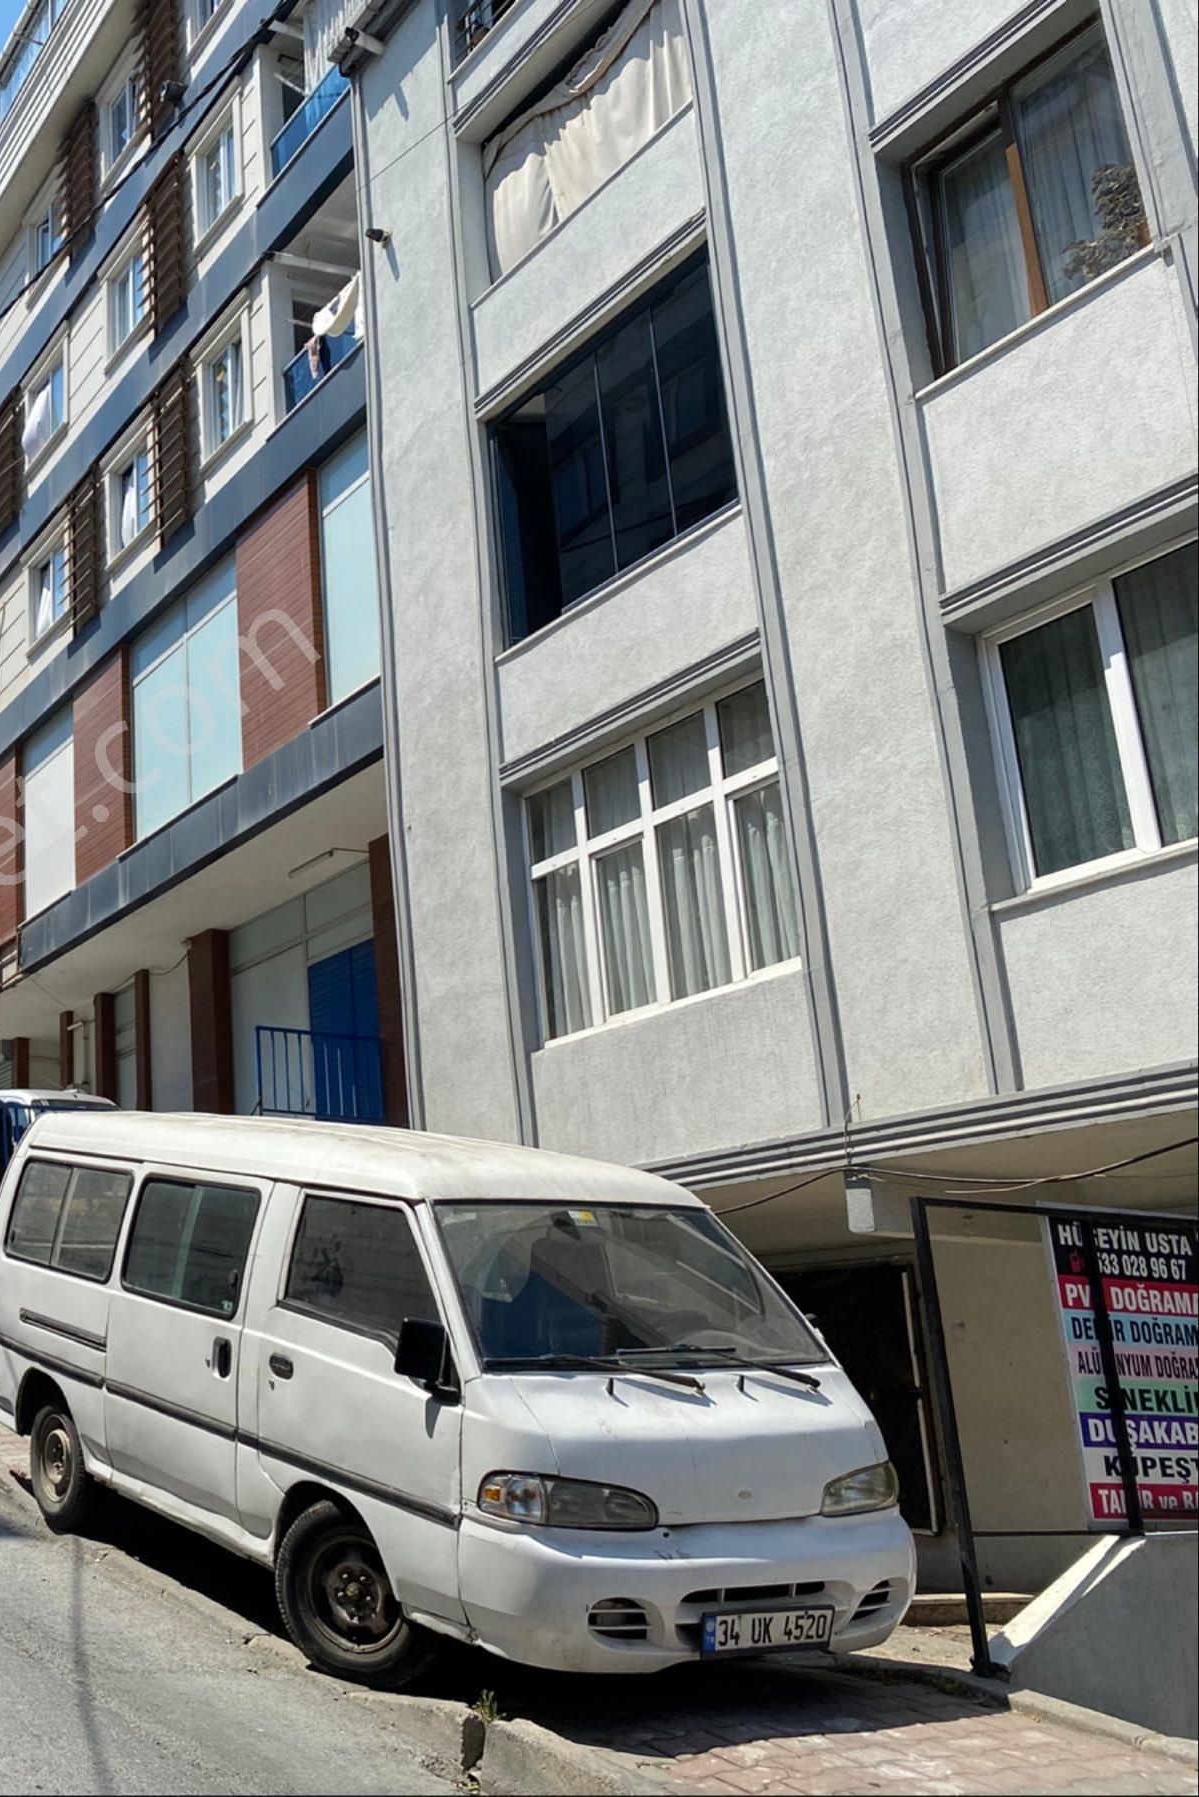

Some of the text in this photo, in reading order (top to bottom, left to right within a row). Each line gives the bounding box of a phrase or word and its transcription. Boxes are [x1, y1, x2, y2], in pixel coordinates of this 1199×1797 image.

[1058, 1221, 1193, 1256] HÜEYİN USTA
[1122, 1255, 1149, 1278] 028
[1150, 1259, 1168, 1280] 96
[1170, 1259, 1187, 1281] 67
[1064, 1283, 1091, 1308] PV
[1071, 1316, 1126, 1342] DER
[1078, 1346, 1198, 1380] ALÜNYUM DOĞRA
[1094, 1385, 1198, 1415] SNEKLİ
[1098, 1488, 1154, 1515] TAR
[1158, 1495, 1179, 1511] ve
[718, 1618, 740, 1647] 34
[751, 1616, 773, 1644] UK
[783, 1613, 827, 1641] 4520
